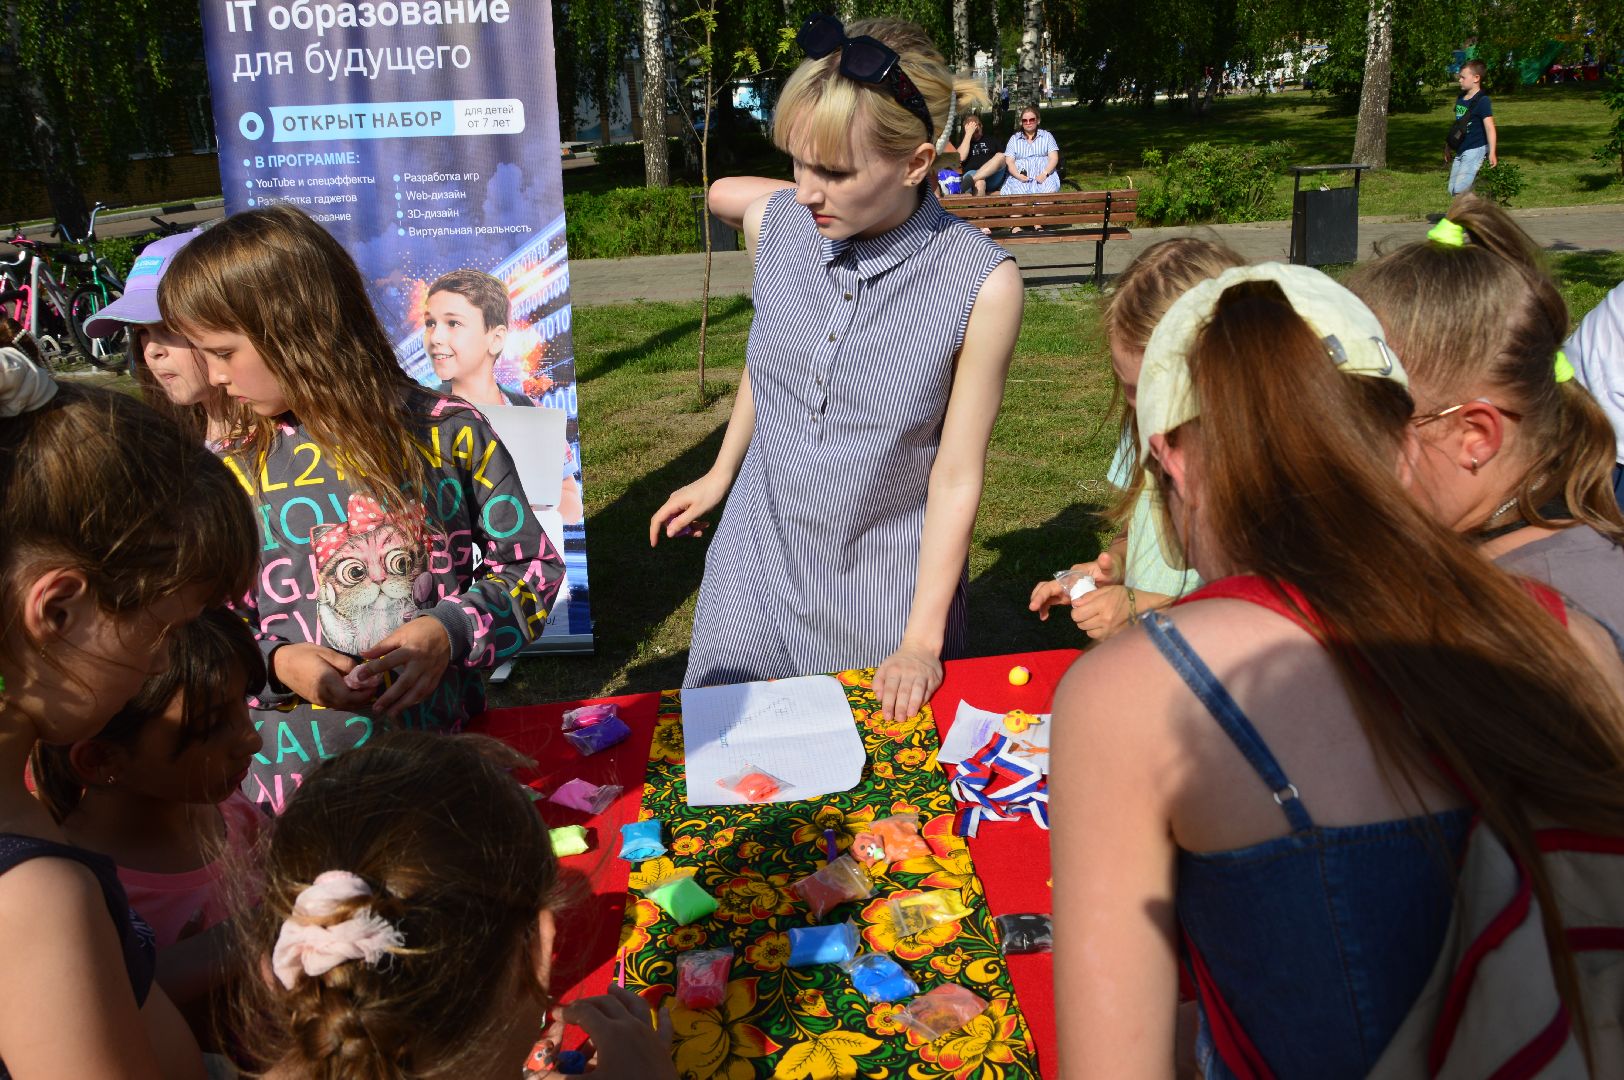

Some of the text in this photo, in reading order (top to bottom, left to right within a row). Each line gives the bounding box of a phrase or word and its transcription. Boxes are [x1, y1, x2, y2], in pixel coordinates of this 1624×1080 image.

[225, 0, 511, 36] IT образование
[233, 42, 471, 82] для будущего
[465, 105, 514, 116] для детей
[282, 111, 442, 132] ОТКРЫТ НАБОР
[467, 117, 511, 129] от 7 лет
[255, 152, 360, 168] В ПРОГРАММЕ:
[256, 174, 376, 188] YouTube и спецэффекты
[404, 172, 480, 184] Разработка игр
[314, 194, 358, 205] гаджетов
[406, 189, 467, 201] Web-дизайн
[407, 208, 460, 220] 3D-дизайн
[408, 225, 532, 237] Виртуальная реальность
